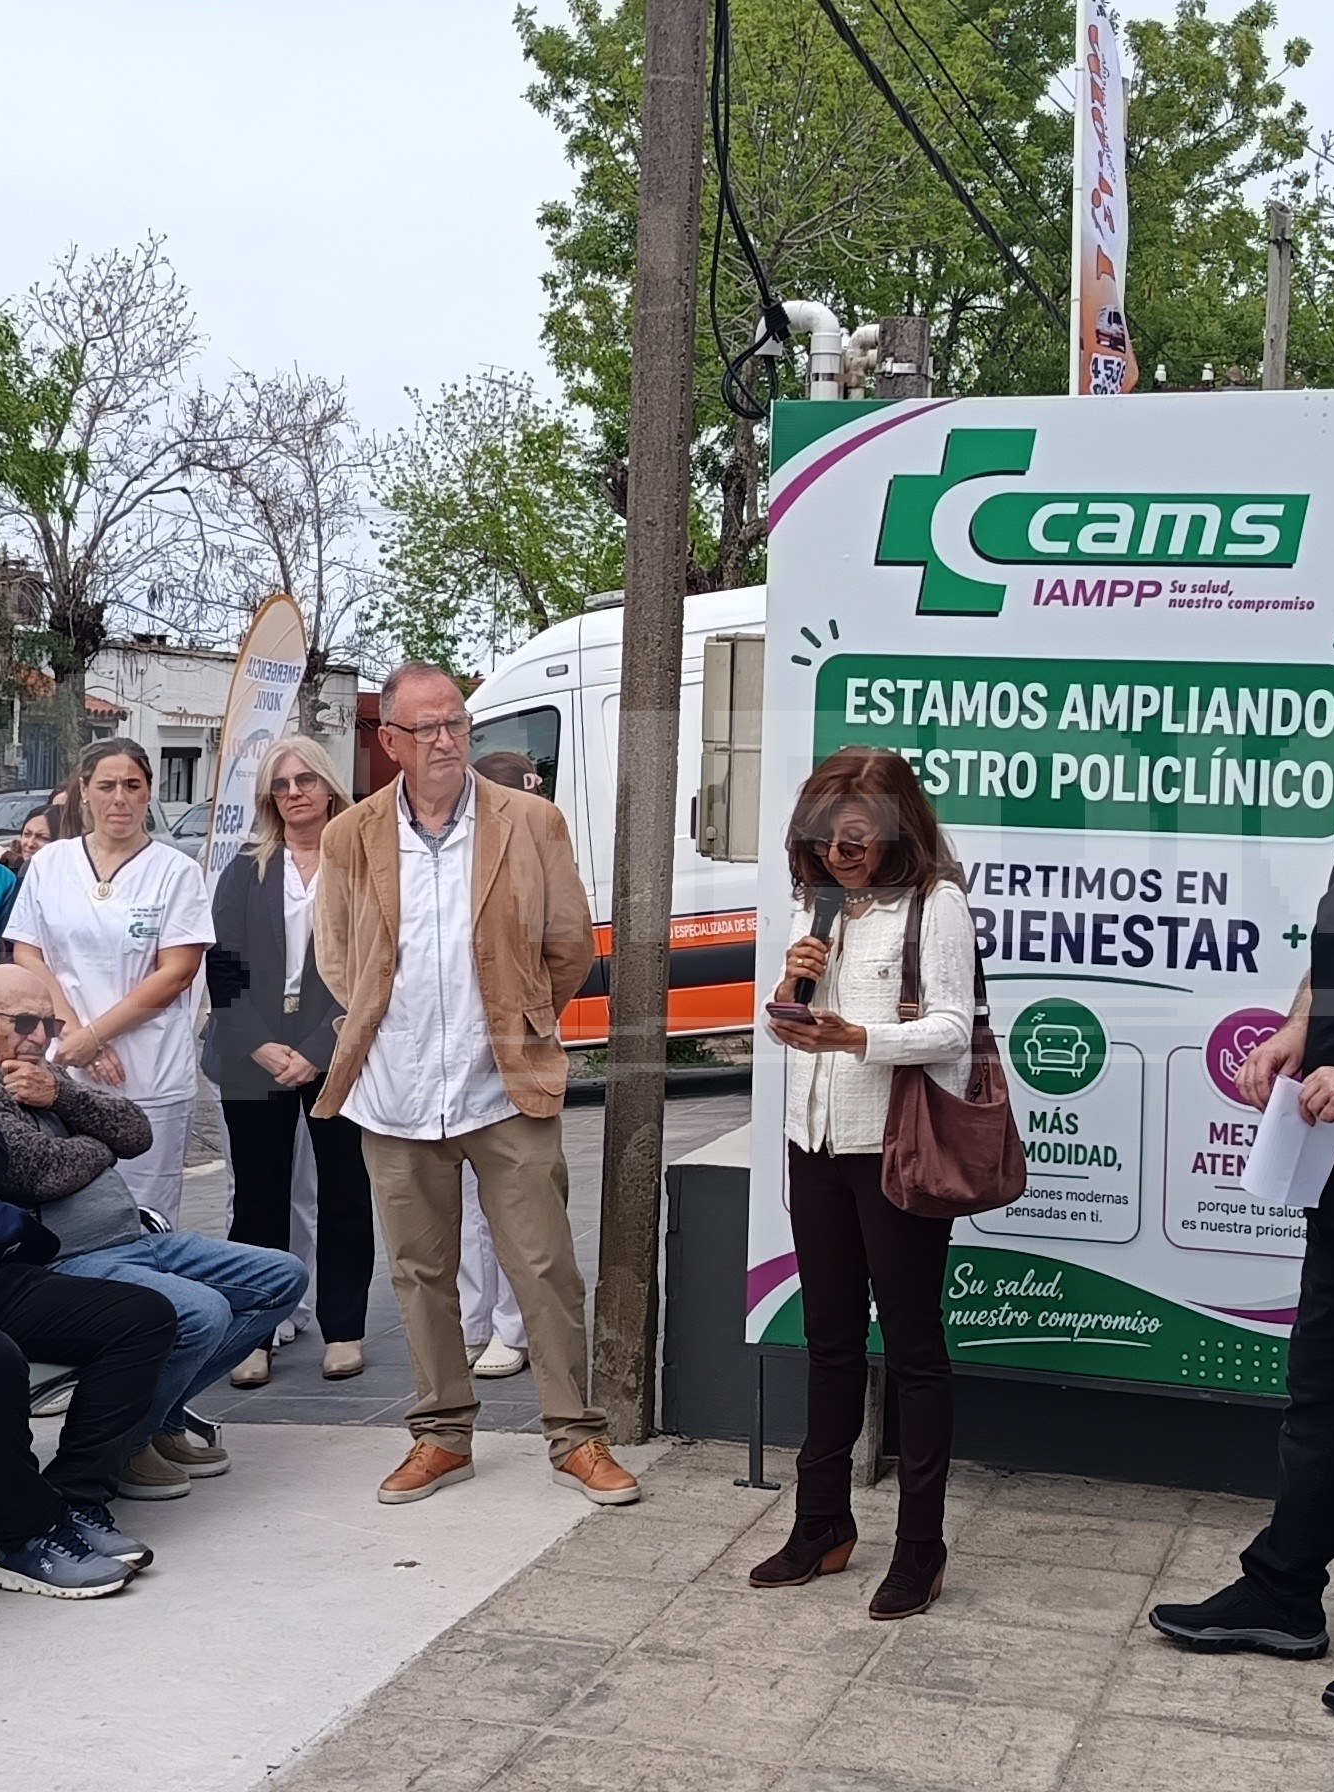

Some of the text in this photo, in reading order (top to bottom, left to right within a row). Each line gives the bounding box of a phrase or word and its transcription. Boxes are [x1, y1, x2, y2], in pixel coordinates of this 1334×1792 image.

[1027, 502, 1285, 556] cams
[1032, 578, 1162, 607] IAMPP
[1169, 580, 1234, 597] Su salud,
[1168, 596, 1315, 613] nuestro compromiso
[845, 678, 1049, 730] ESTAMOS
[1051, 746, 1334, 811] POLICLÍNICO
[1177, 870, 1228, 905] EN
[675, 921, 734, 938] ESPECIALIZADA
[735, 920, 746, 932] DE
[1029, 1106, 1079, 1135] MÁS
[1065, 1190, 1129, 1205] modernas
[1197, 1200, 1247, 1216] porque
[1250, 1203, 1265, 1216] tu
[1006, 1206, 1103, 1223] pensadas en ti.
[1181, 1219, 1197, 1230] es
[1200, 1221, 1252, 1234] nuestra
[948, 1263, 1064, 1301] Su salud,
[948, 1302, 1163, 1338] nuestro compromiso
